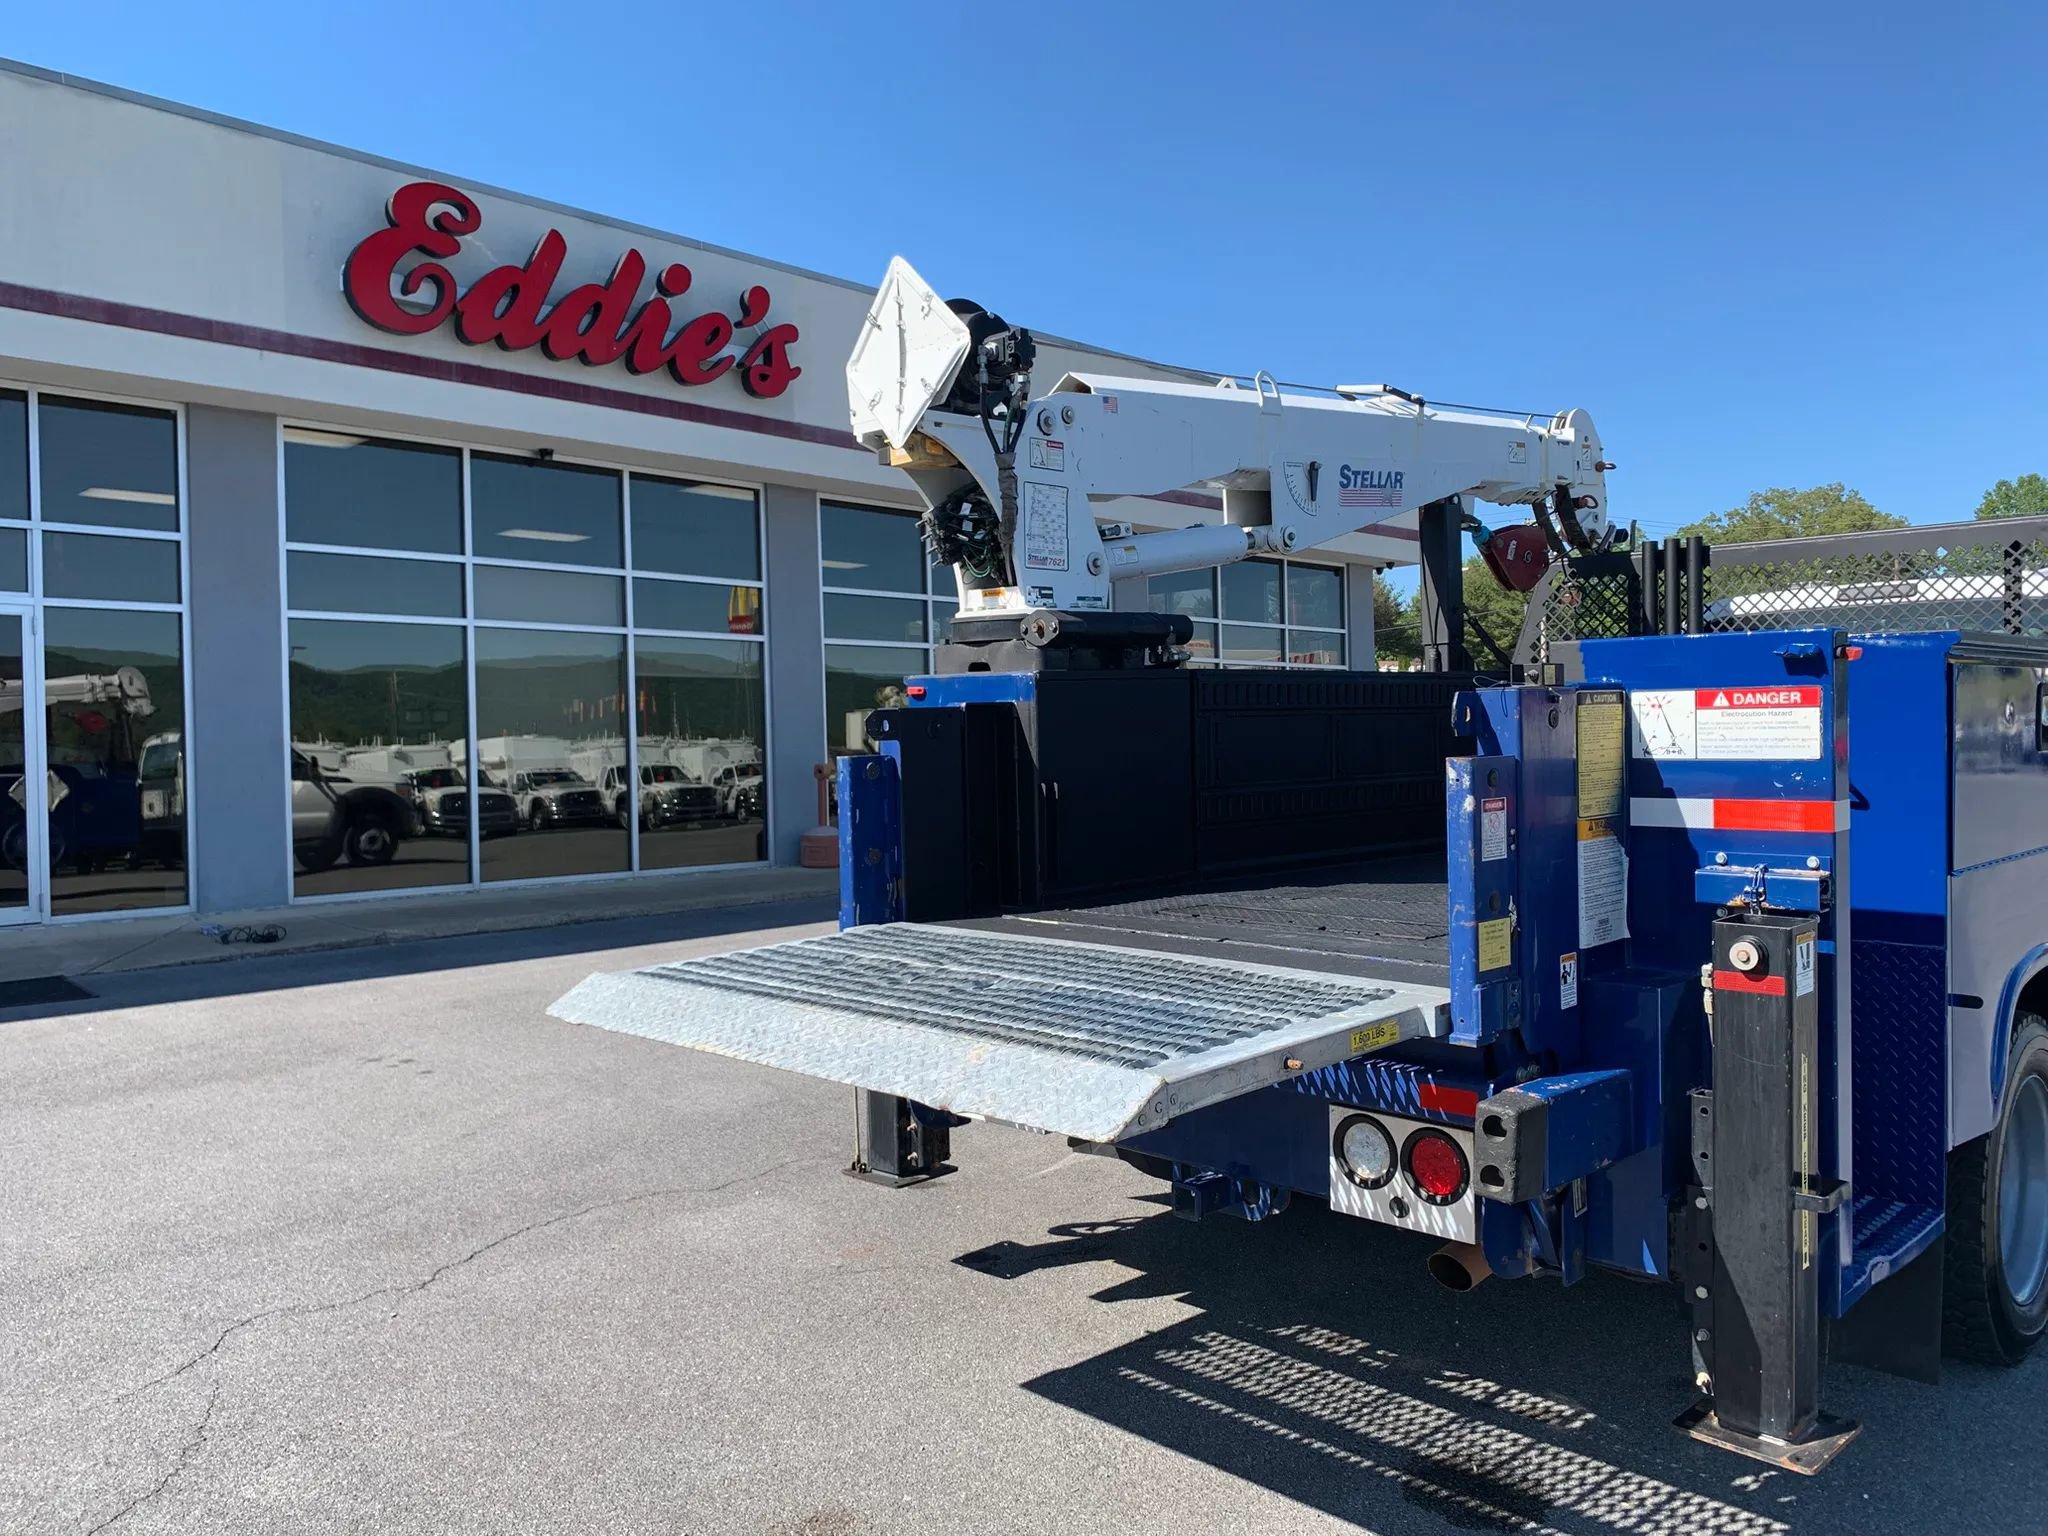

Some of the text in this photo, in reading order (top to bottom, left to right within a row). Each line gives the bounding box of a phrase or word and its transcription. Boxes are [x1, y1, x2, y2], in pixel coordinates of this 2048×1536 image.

[343, 181, 802, 399] Eddie's
[1339, 464, 1403, 489] STELLAR
[1048, 557, 1066, 567] 7621
[1593, 694, 1617, 703] CAUTION
[1733, 691, 1802, 705] DANGER
[1372, 1027, 1386, 1039] LBS
